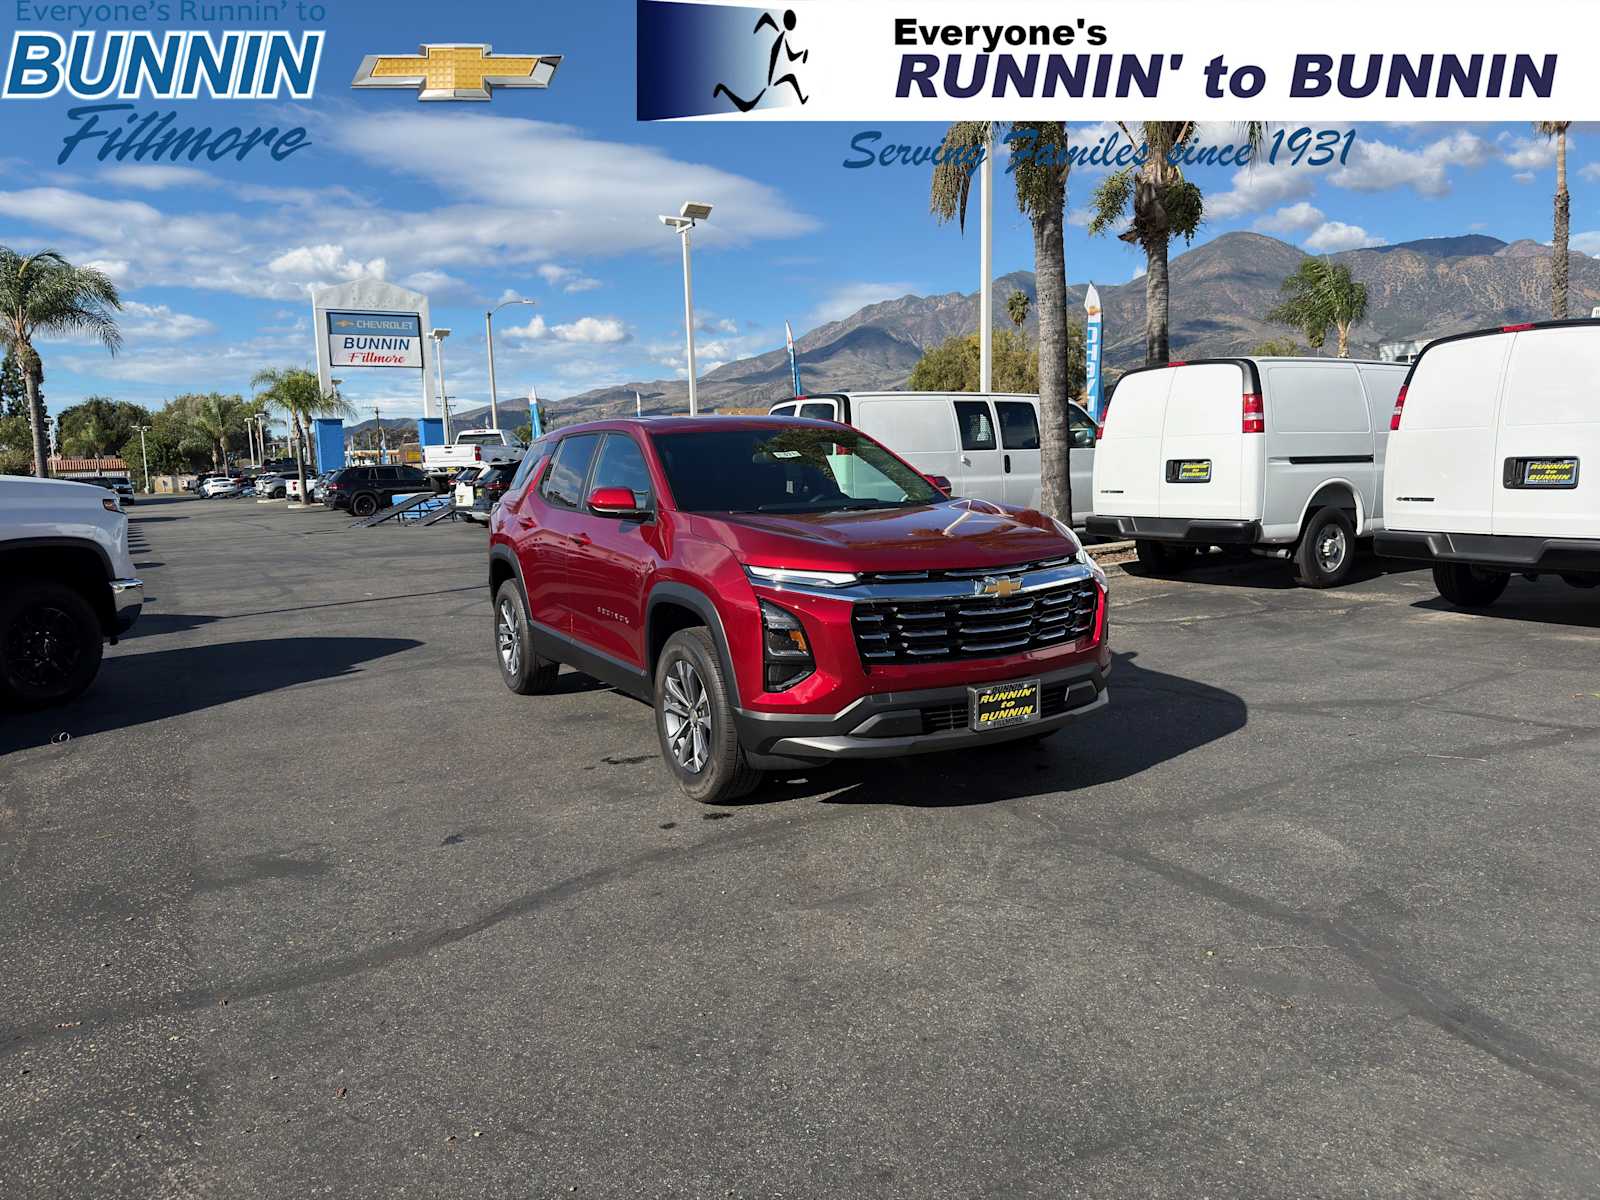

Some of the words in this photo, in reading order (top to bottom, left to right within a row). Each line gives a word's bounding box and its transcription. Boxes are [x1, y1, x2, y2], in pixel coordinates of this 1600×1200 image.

[356, 319, 413, 330] CHEVROLET
[344, 337, 410, 350] BUNNIN
[350, 351, 406, 364] Fillmore
[980, 687, 1036, 704] RUNNIN'
[980, 705, 1033, 721] BUNNIN
